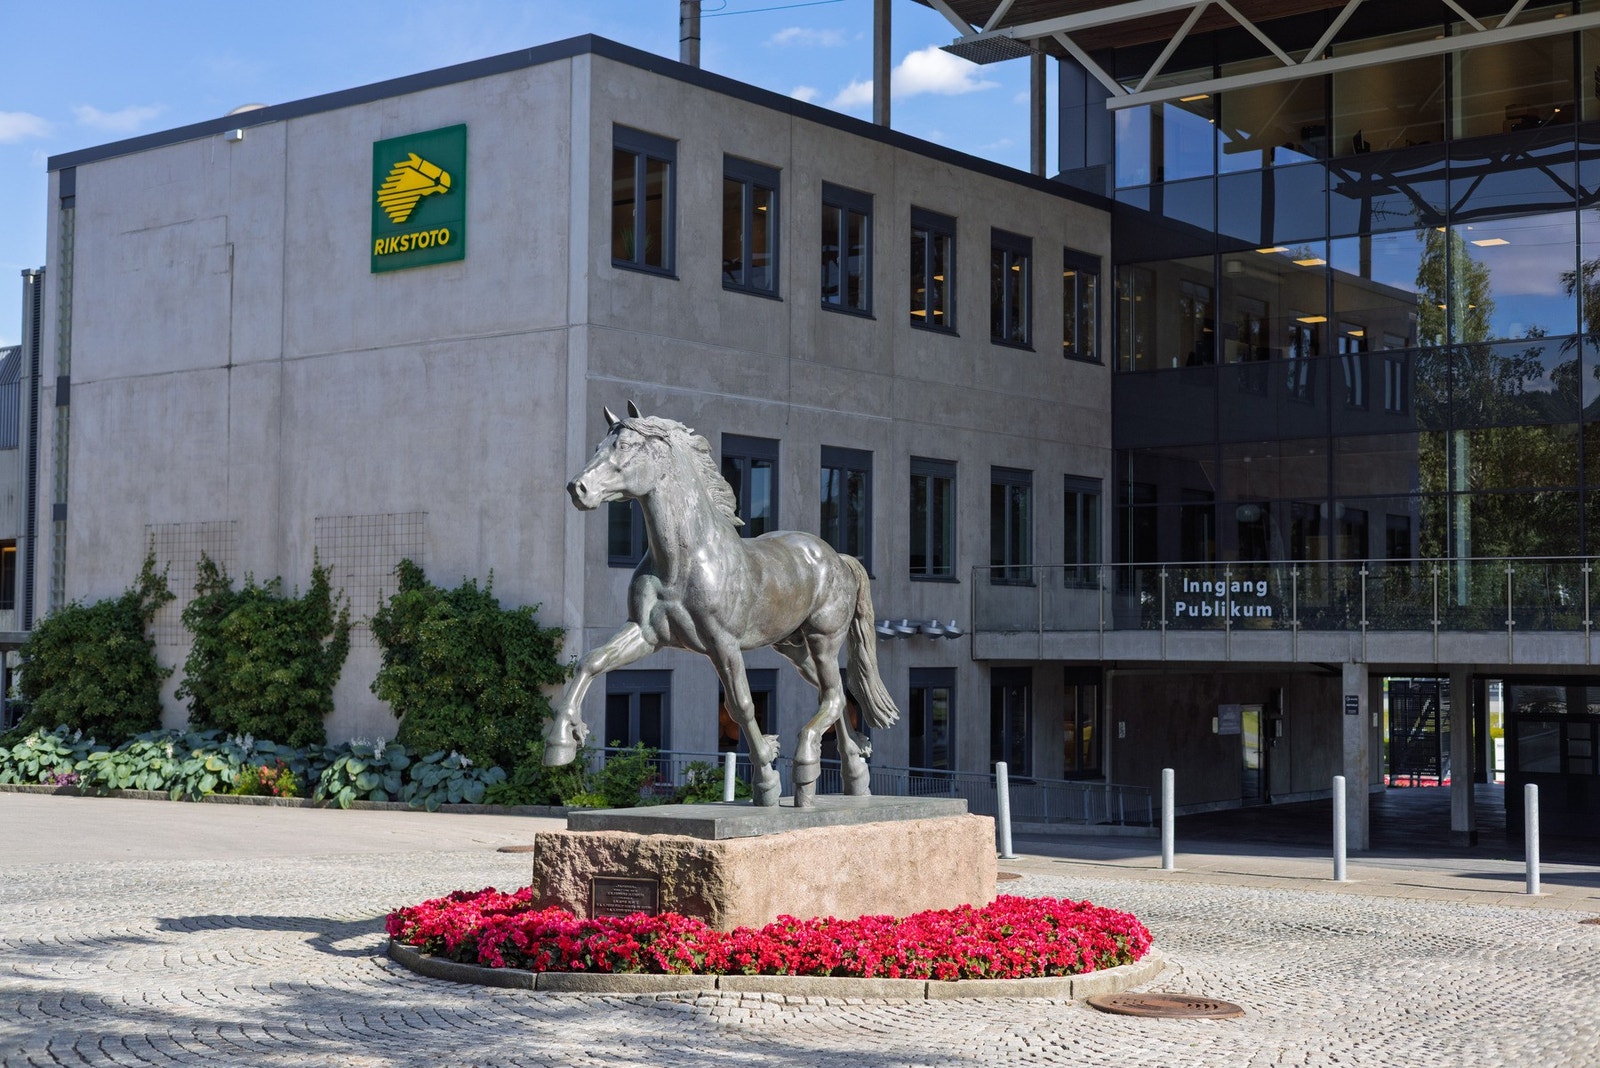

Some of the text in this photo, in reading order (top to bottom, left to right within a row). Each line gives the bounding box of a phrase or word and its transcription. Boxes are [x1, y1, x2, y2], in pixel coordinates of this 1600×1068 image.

[374, 228, 450, 256] RIKSTOTO
[1183, 577, 1268, 597] Inngang
[1175, 600, 1273, 617] Publikum
